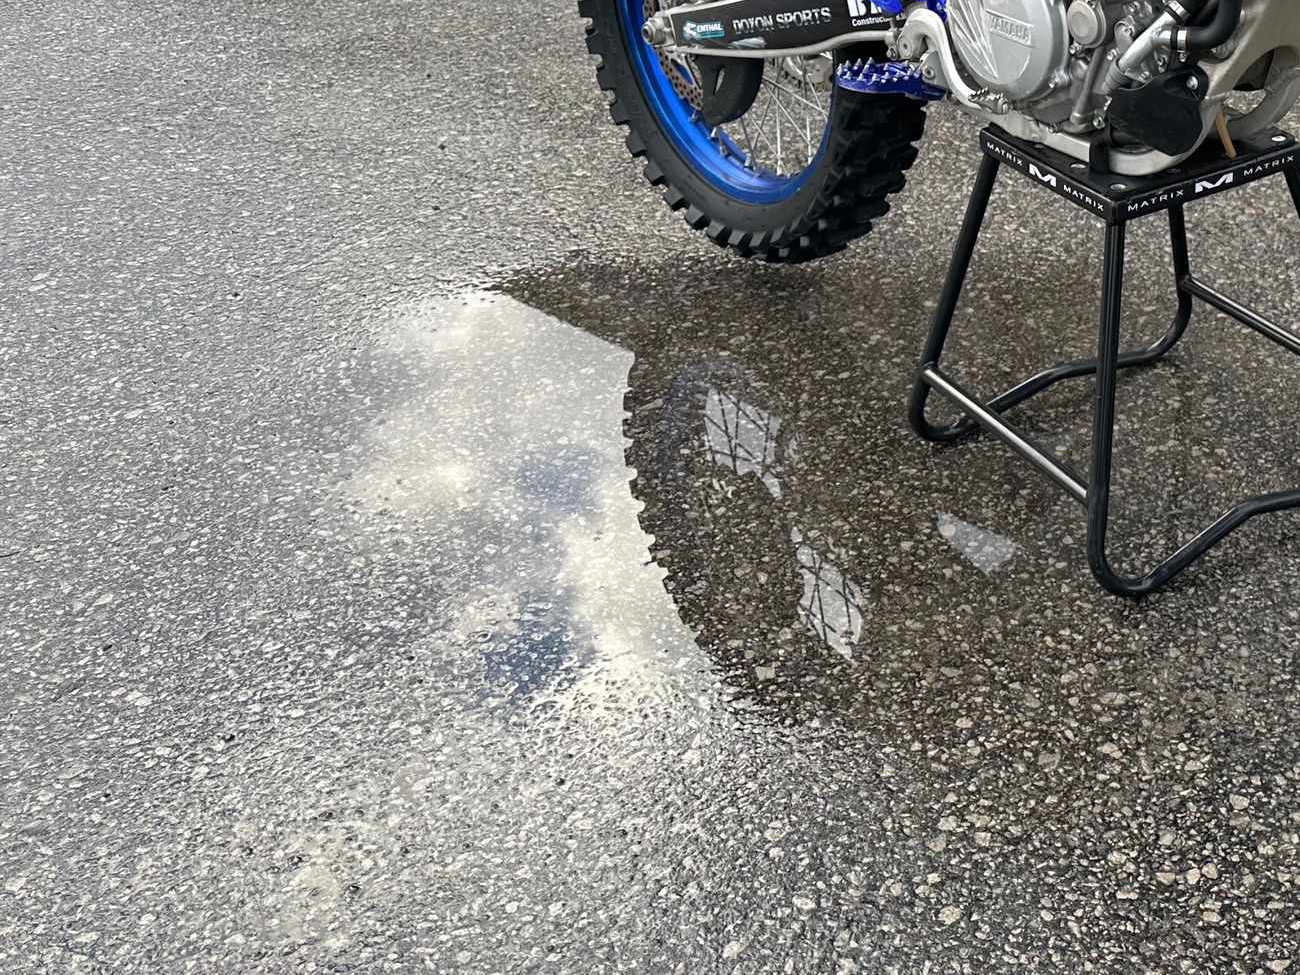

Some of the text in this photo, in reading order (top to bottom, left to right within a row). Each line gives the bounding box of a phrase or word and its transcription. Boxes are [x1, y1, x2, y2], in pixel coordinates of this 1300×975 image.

[775, 7, 832, 29] SPORTS
[990, 15, 1030, 43] YAMAHA
[987, 141, 1023, 167] MATRIX
[1063, 184, 1105, 212] MATRIX
[1127, 188, 1185, 212] MATRIX
[1242, 154, 1295, 177] MATRIX
